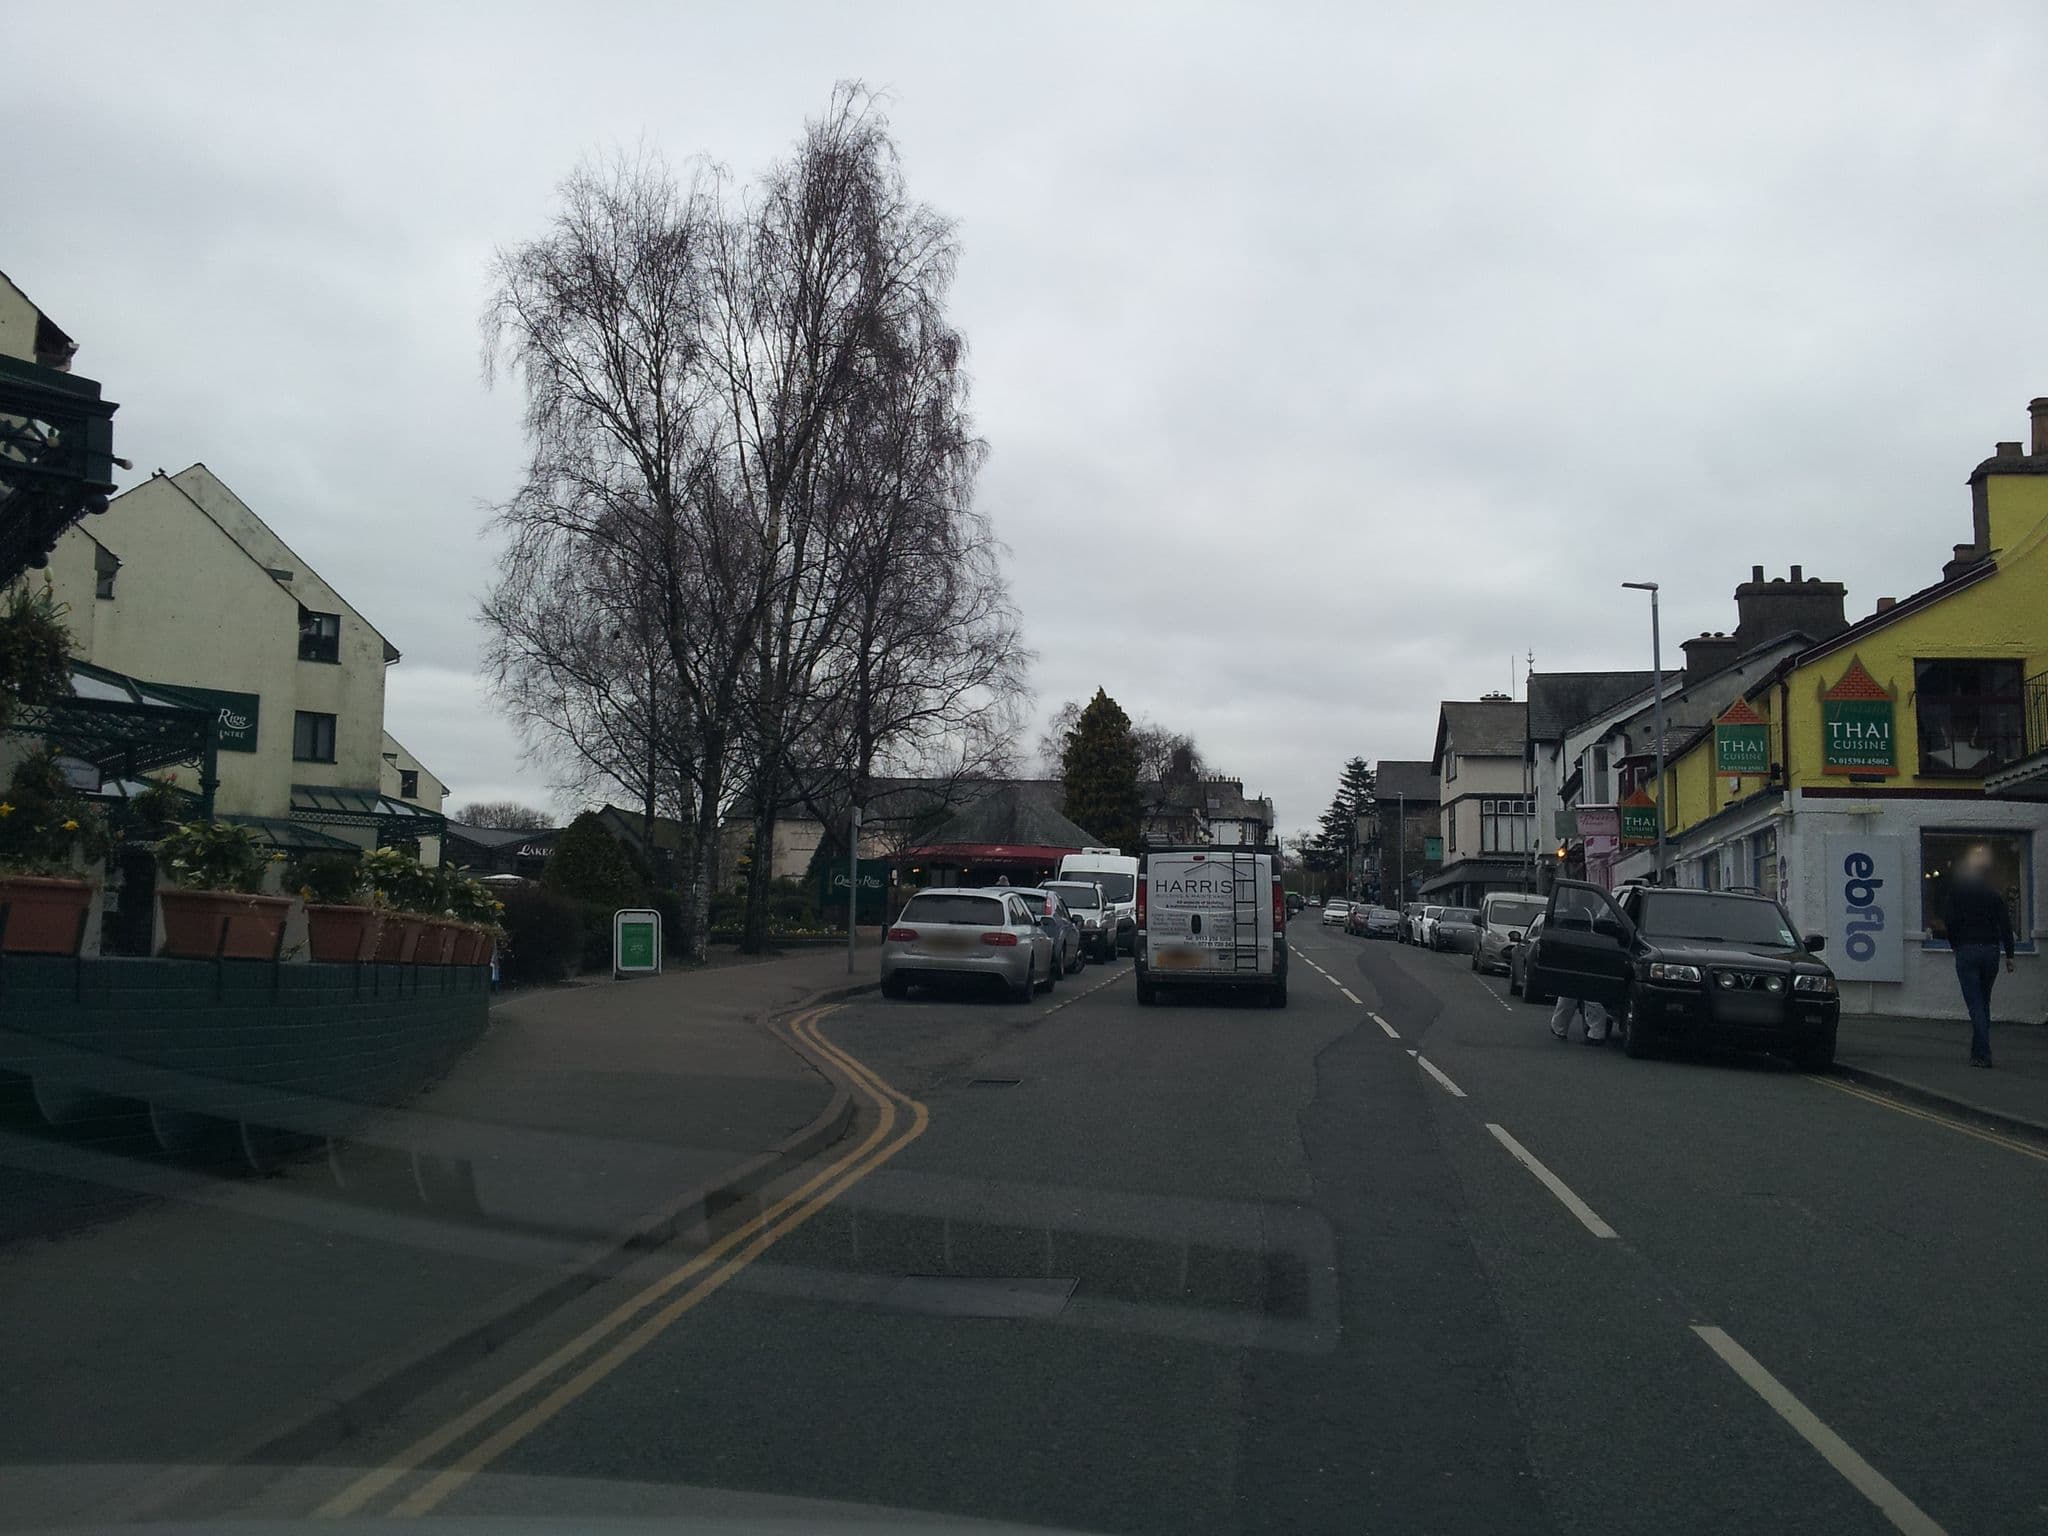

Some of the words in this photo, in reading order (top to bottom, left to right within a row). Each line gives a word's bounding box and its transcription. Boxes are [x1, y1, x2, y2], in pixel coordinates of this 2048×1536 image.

[218, 708, 253, 730] Rigg
[1828, 722, 1889, 738] THAI
[1720, 740, 1764, 752] THAI
[1833, 740, 1887, 750] CUISINE
[1624, 816, 1656, 827] THAI
[1155, 879, 1233, 894] HARRIS
[1844, 852, 1884, 962] ebflo
